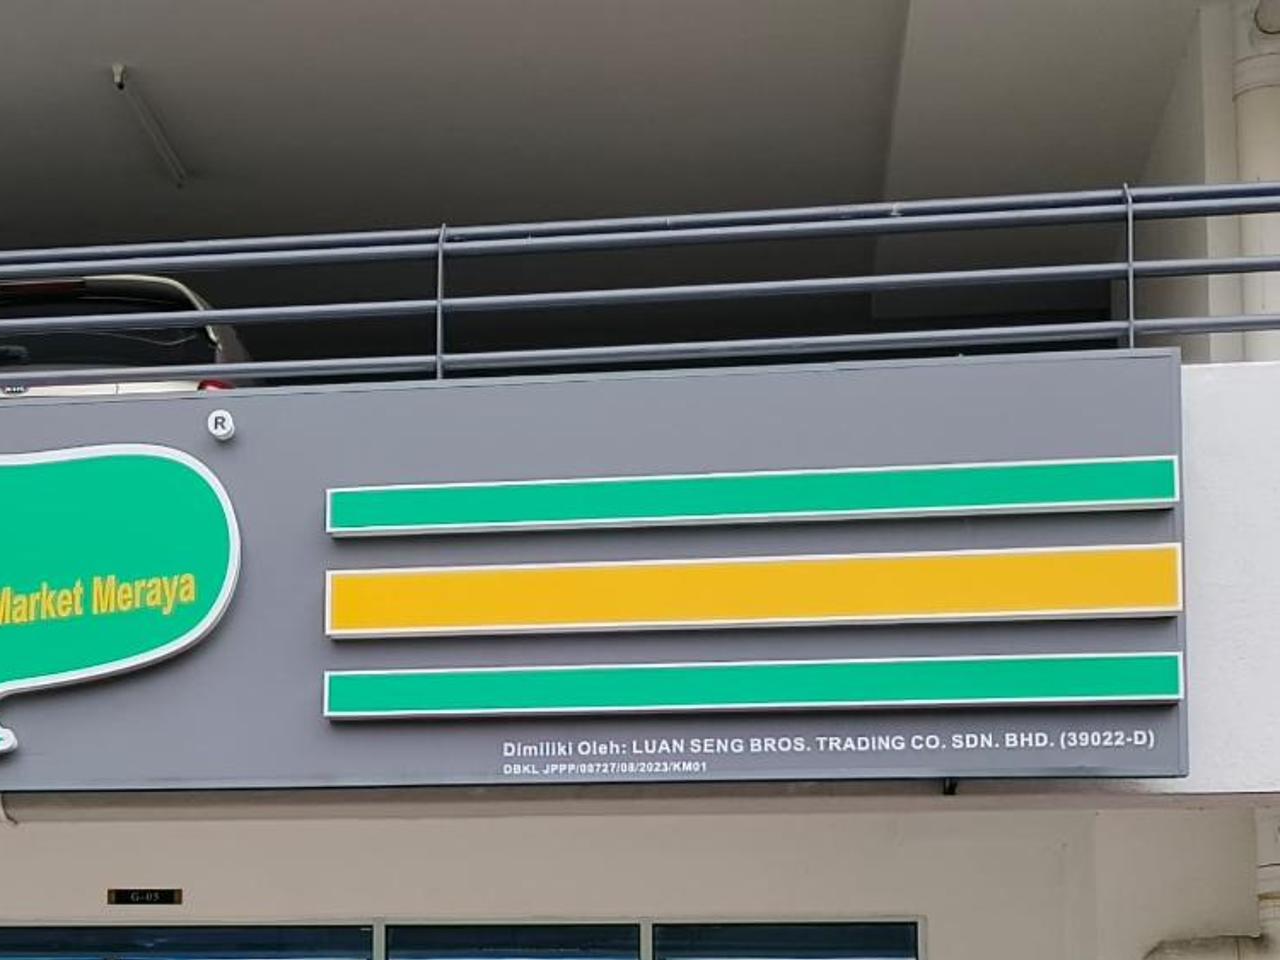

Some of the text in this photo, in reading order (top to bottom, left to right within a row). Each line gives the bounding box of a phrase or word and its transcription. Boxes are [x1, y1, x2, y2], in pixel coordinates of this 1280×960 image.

[92, 573, 196, 616] Meraya
[503, 730, 1155, 757] Dimiliki Oleh: LUAN SENG BROS. TRADING CO. SDN. BHD. (39022-D)
[503, 763, 539, 775] DBKL
